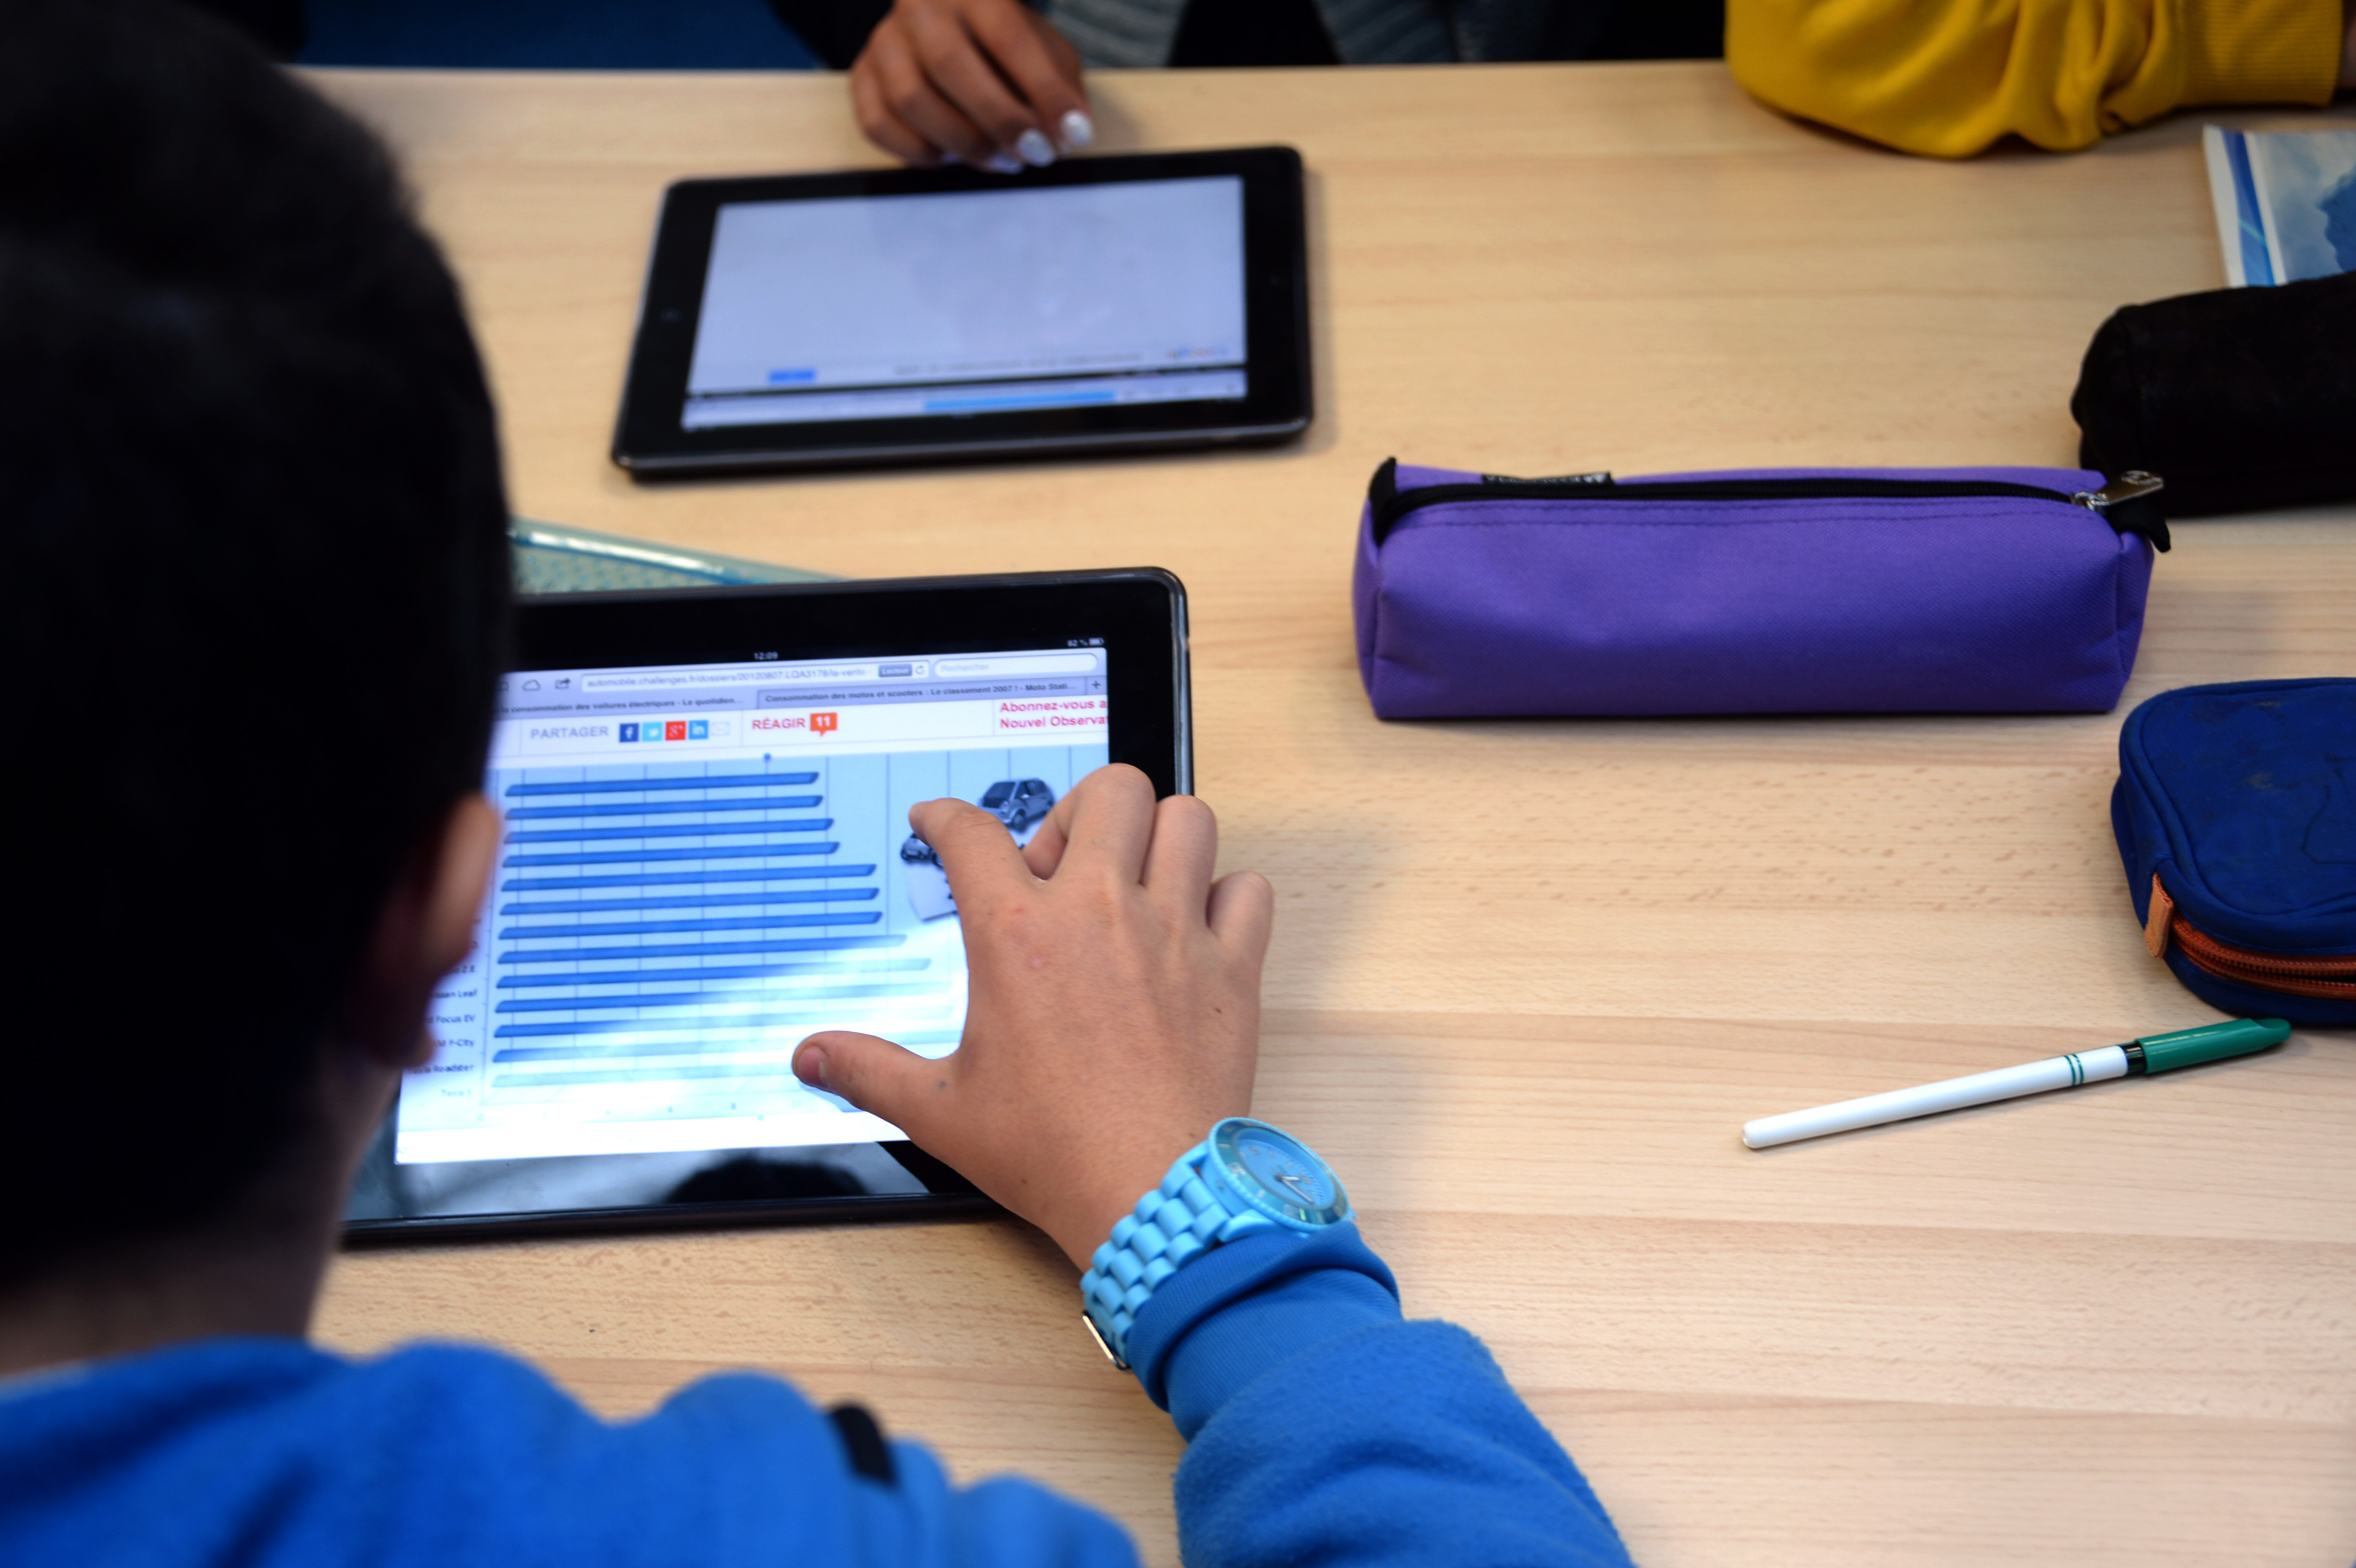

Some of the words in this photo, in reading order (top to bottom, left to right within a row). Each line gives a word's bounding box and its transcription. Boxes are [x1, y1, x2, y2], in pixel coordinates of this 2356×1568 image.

[753, 651, 779, 660] 12:09
[765, 693, 829, 702] Consommation
[849, 691, 874, 700] motos
[887, 689, 924, 697] scooters
[944, 686, 991, 695] classement
[511, 701, 573, 712] consommation
[593, 700, 627, 709] voitures
[1001, 700, 1094, 712] Abonnez-vous
[752, 715, 806, 730] RÉAGIR
[815, 714, 831, 727] 11
[1001, 716, 1046, 729] Nouvel
[530, 725, 609, 739] PARTAGER
